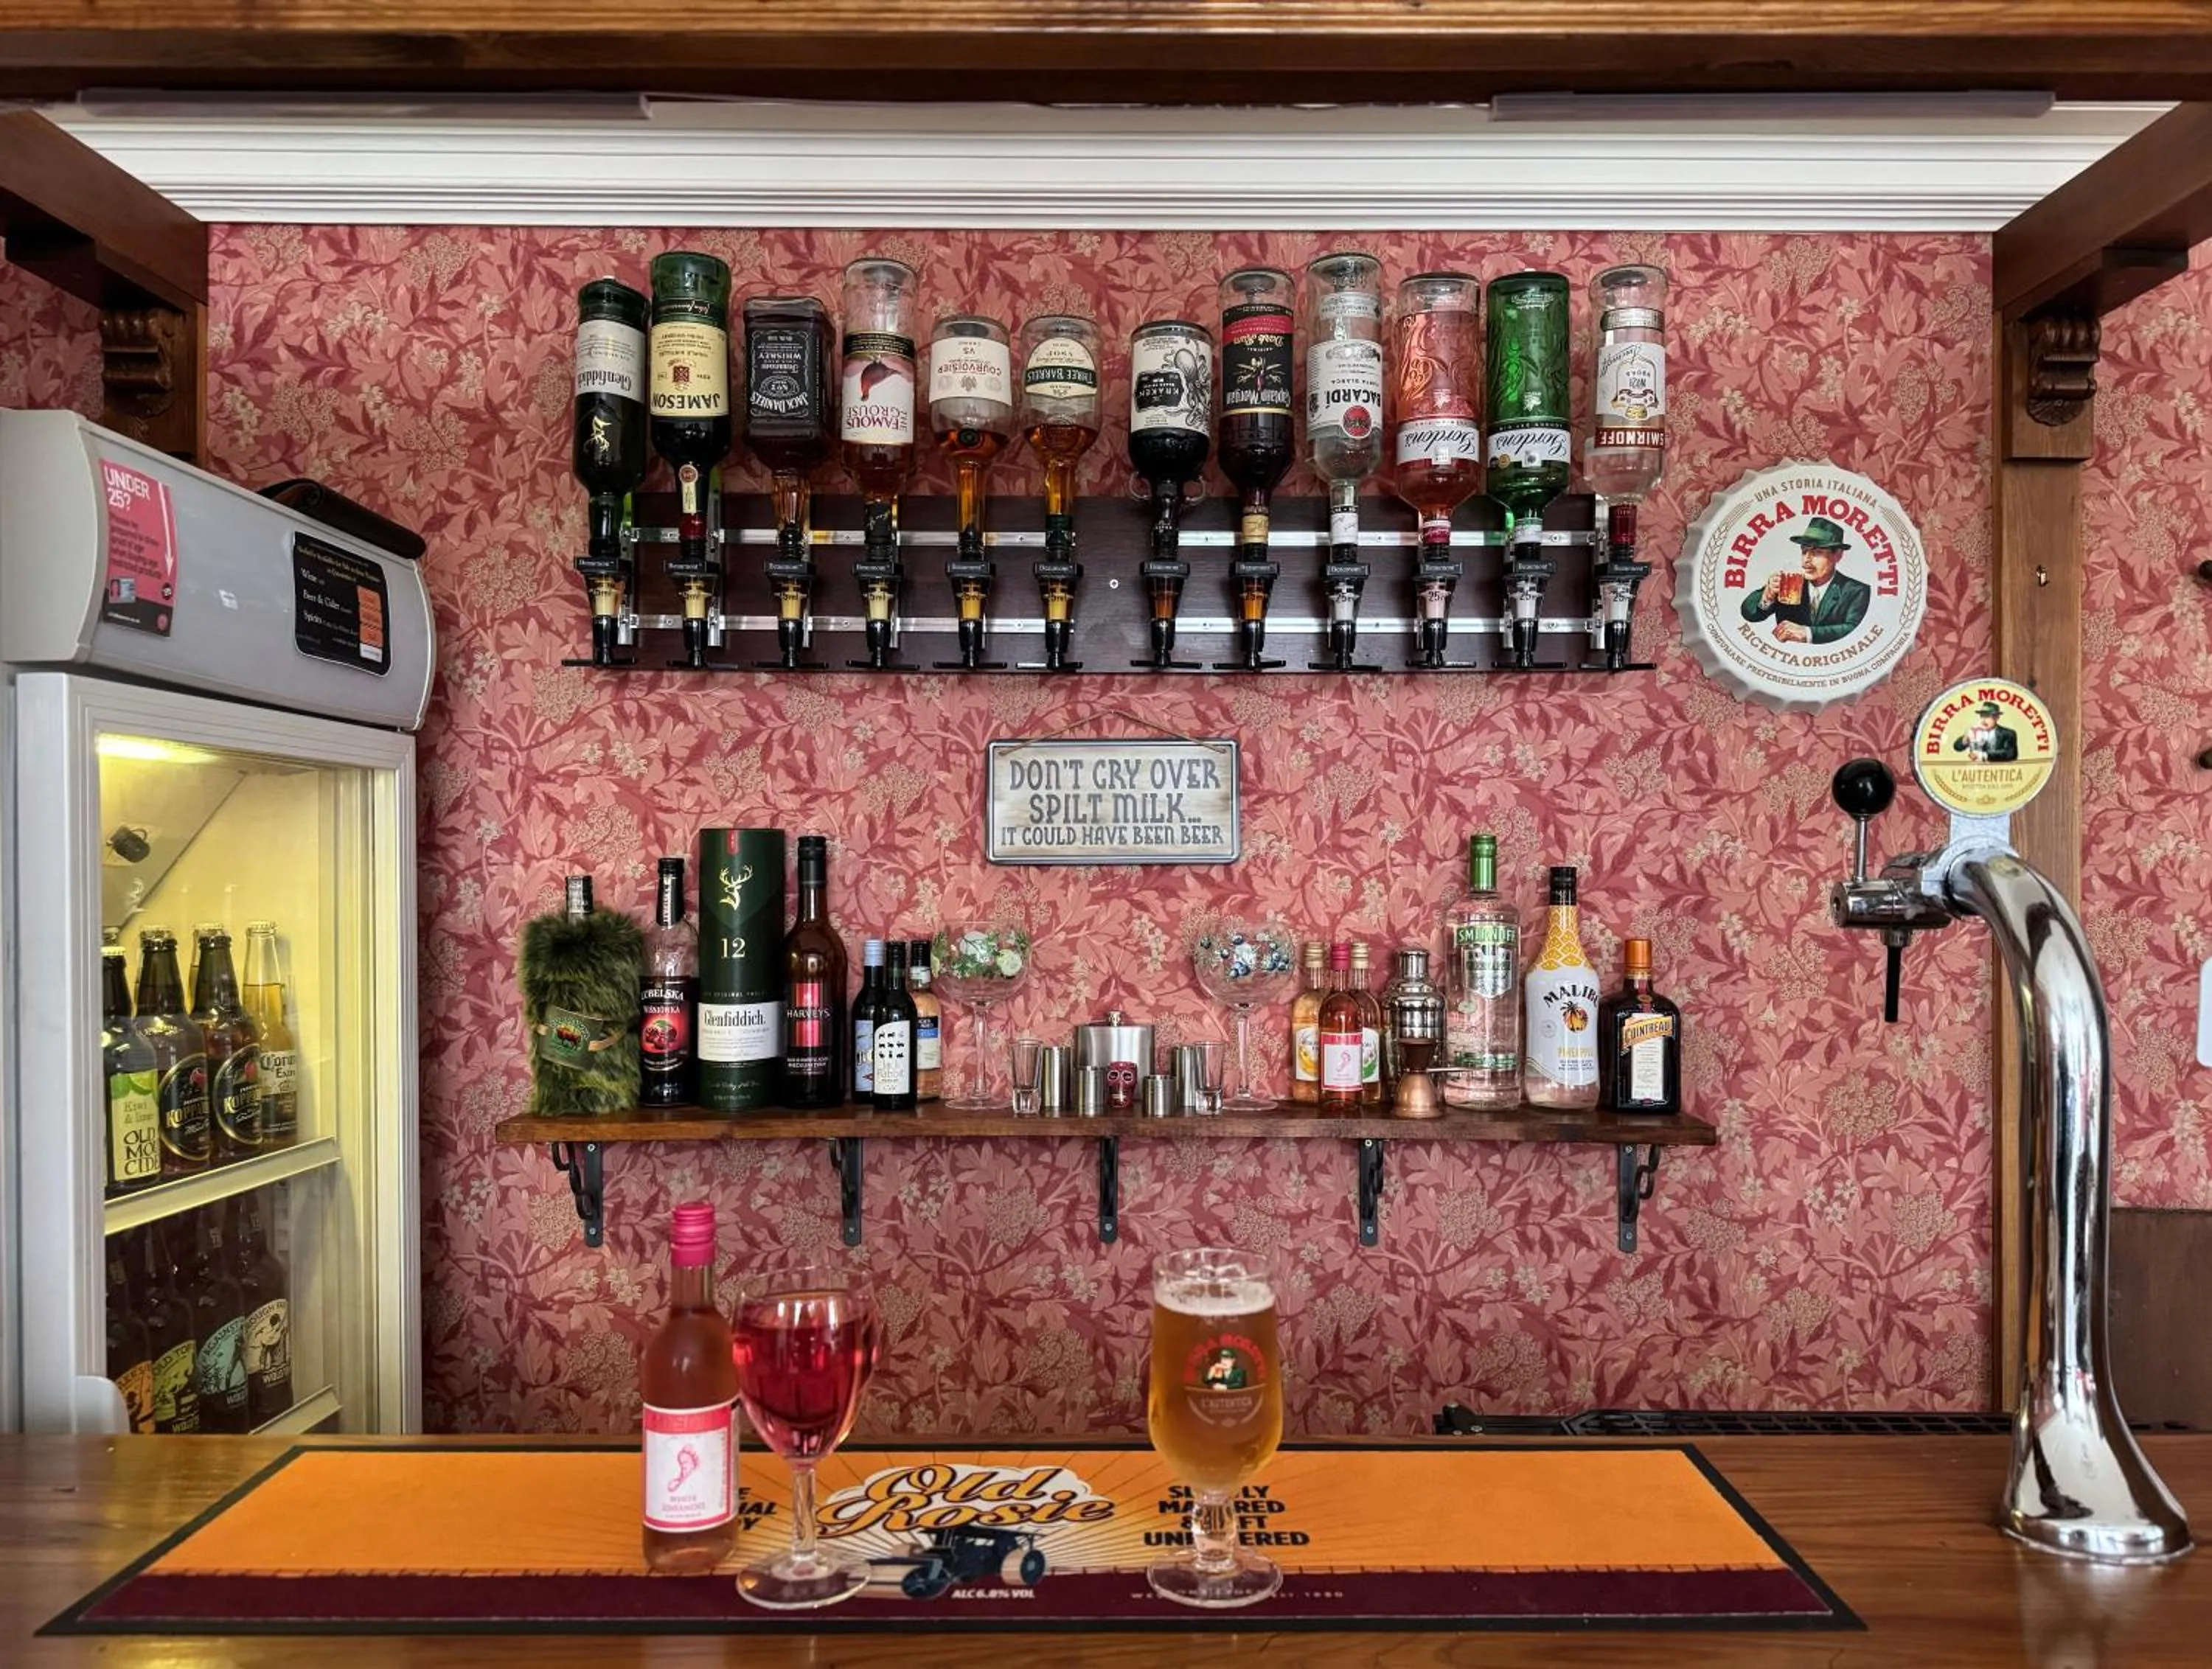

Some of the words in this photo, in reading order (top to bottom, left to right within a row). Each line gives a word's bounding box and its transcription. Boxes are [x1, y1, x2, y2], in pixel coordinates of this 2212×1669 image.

[1258, 335, 1284, 347] Dark
[937, 363, 1002, 377] COURVOISIER
[1027, 368, 1065, 382] BARRELS
[1066, 369, 1093, 384] THREE
[652, 392, 720, 409] JAMESON
[786, 392, 809, 410] JACK
[1138, 387, 1179, 397] KRAKEN
[1226, 388, 1259, 405] Morgan
[1260, 388, 1291, 407] Captain
[846, 405, 900, 418] GROUSE
[846, 417, 900, 431] FAMOUS
[1404, 429, 1475, 455] Gordon's
[1495, 429, 1568, 455] Gordon's
[1600, 431, 1663, 445] SMIRNOFF
[104, 465, 151, 501] UNDER
[108, 488, 131, 511] 25?
[1754, 486, 1778, 502] UNA
[1781, 478, 1823, 492] STORIA
[1828, 480, 1877, 508] ITALIANA
[1724, 501, 1795, 589] BIRRA
[1801, 495, 1899, 596] MORETTI
[324, 596, 340, 610] Cider
[1737, 622, 1799, 667] RICETTA
[1802, 624, 1884, 667] ORIGINALE
[1927, 694, 1975, 755] BIRRA
[1978, 689, 2050, 752] MORETTI
[1009, 759, 1084, 790] DON'T
[1093, 759, 1141, 790] CRY
[1150, 759, 1221, 790] OVER
[1952, 768, 2023, 782] L'AUTENTICA
[1029, 792, 1103, 824] SPILT
[1001, 826, 1016, 846] IT
[1022, 826, 1077, 846] COULD
[1082, 826, 1127, 845] HAVE
[1133, 826, 1175, 845] BEEN
[1180, 825, 1224, 844] BEER
[720, 936, 746, 958] 12
[704, 1009, 765, 1027] Glenfiddich
[787, 1008, 831, 1018] HARVEYS
[1624, 1020, 1671, 1044] COINTREAU
[124, 1127, 156, 1144] OLD
[124, 1156, 160, 1175] CIDE
[865, 1463, 1063, 1504] Old
[1168, 1485, 1270, 1498] SLLY
[815, 1491, 1115, 1539] Rosie
[1158, 1500, 1285, 1513] MARED
[952, 1589, 975, 1598] ALC
[1012, 1589, 1035, 1598] VOL
